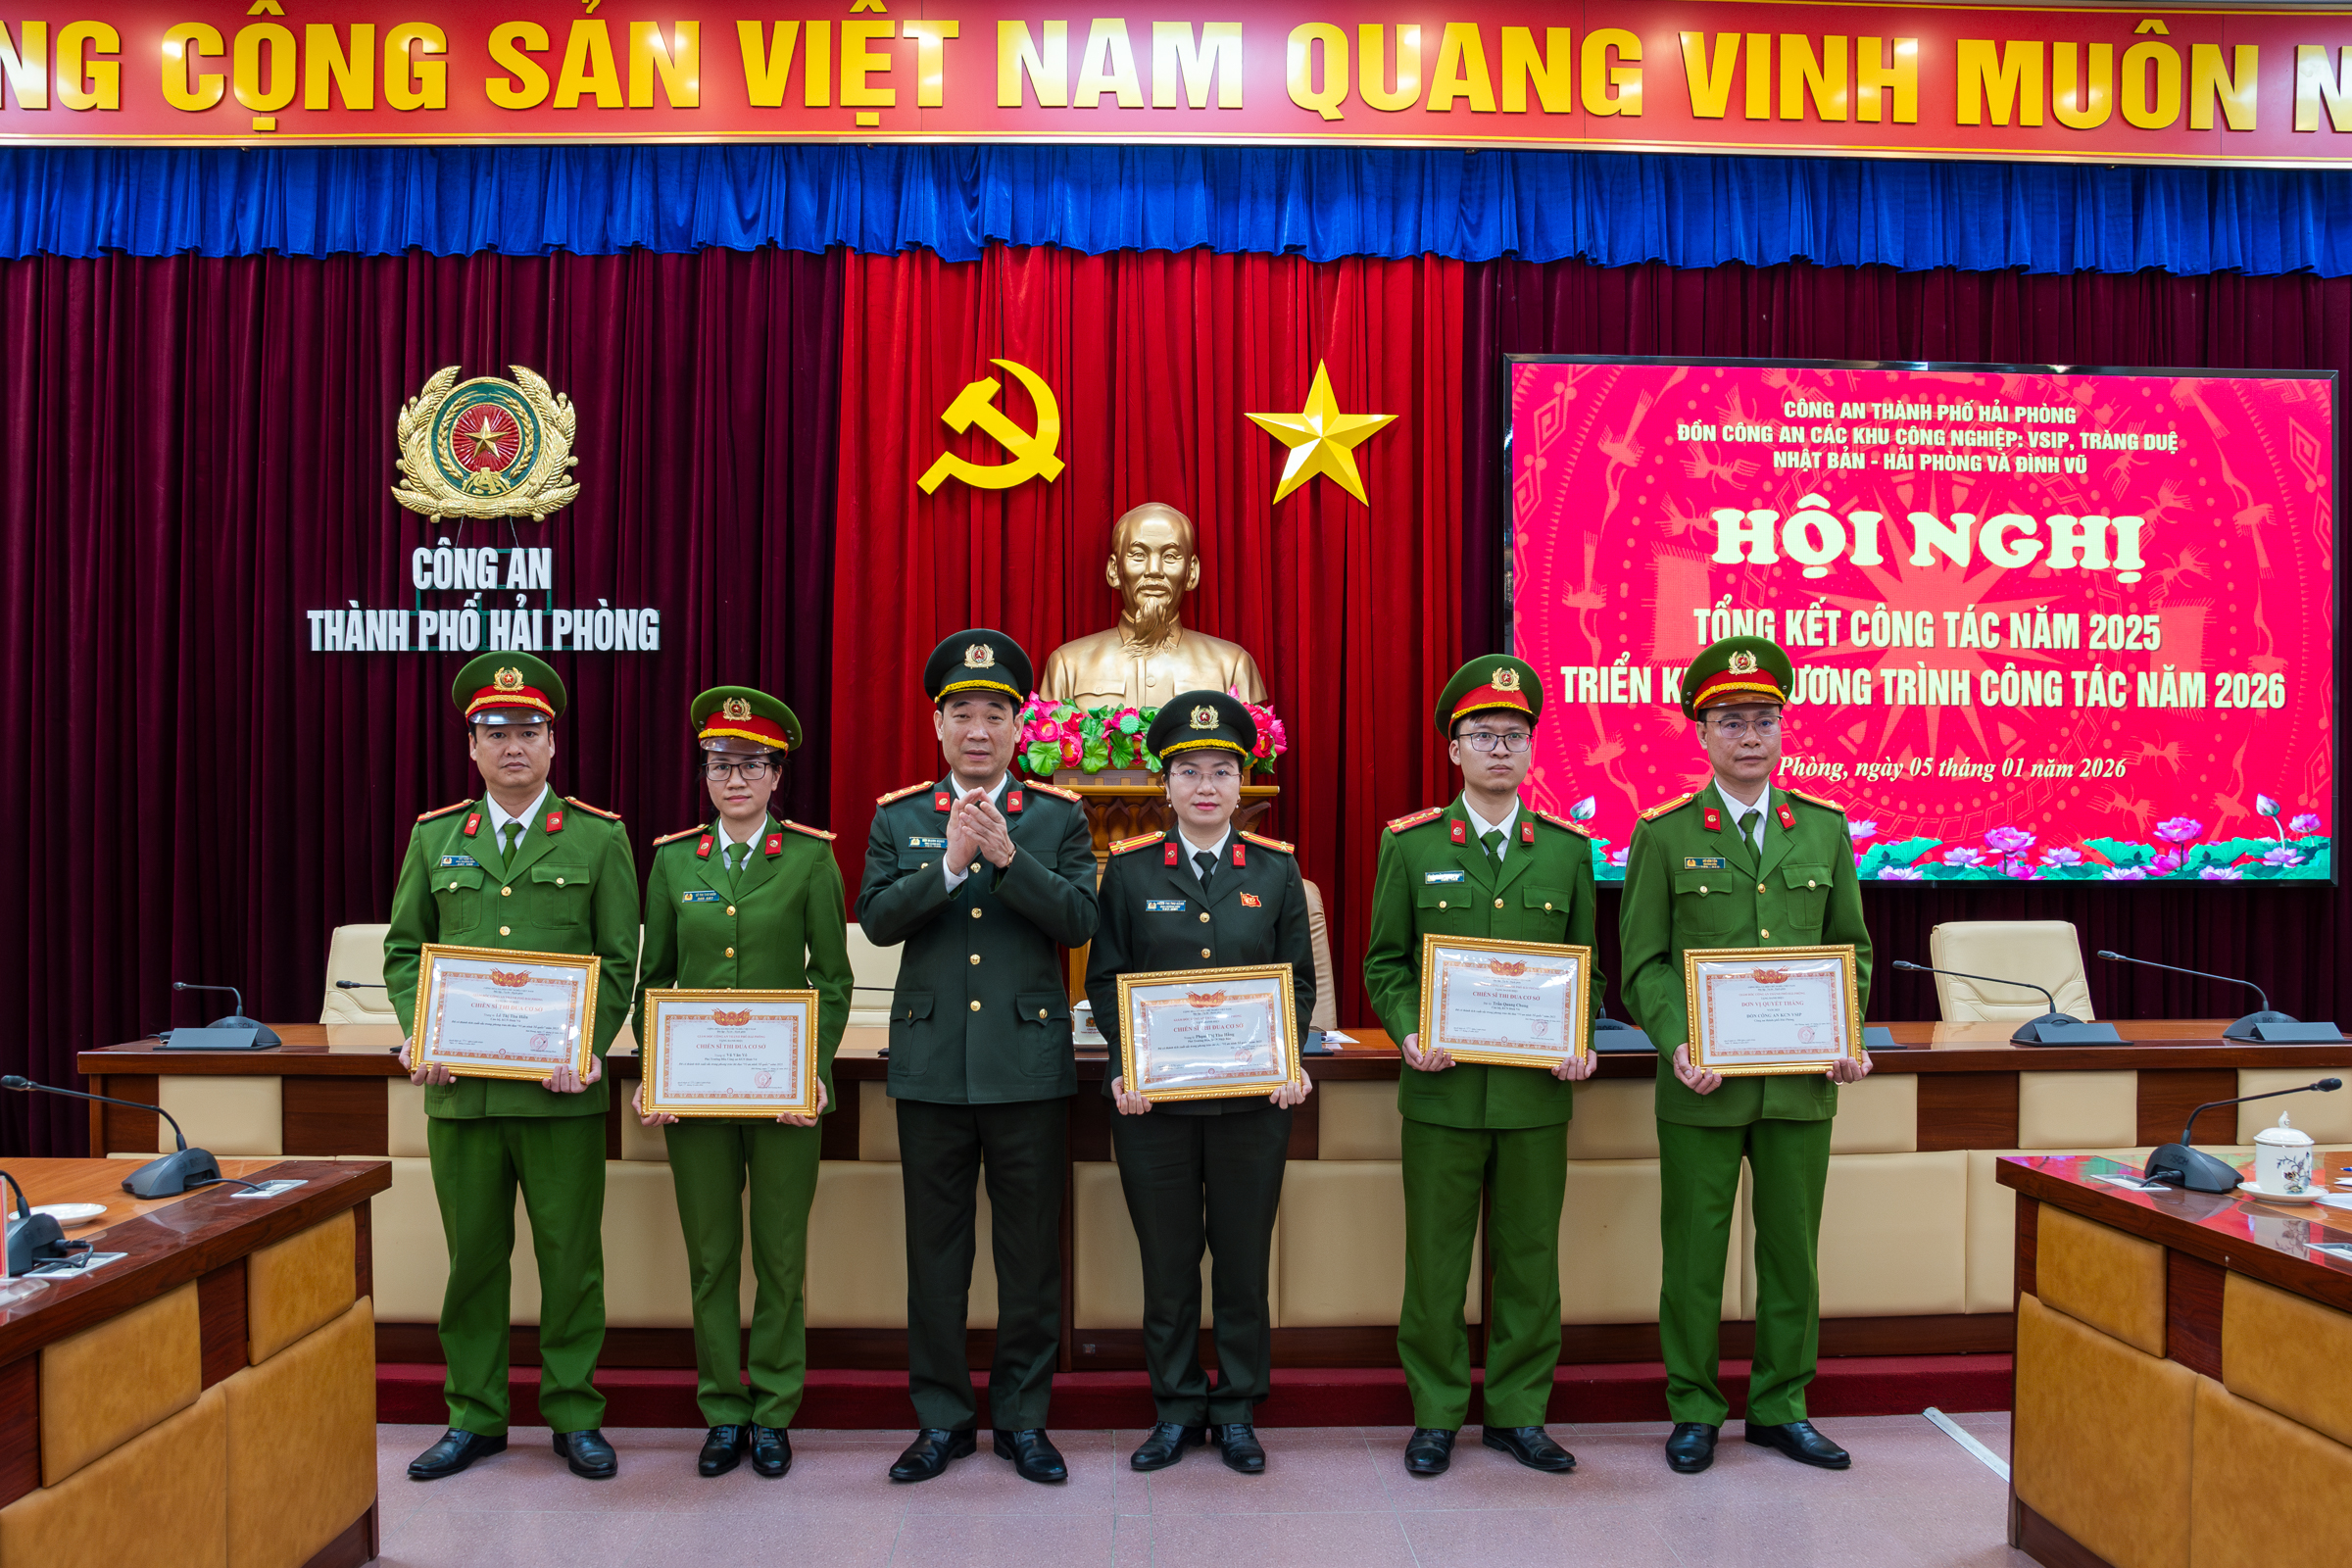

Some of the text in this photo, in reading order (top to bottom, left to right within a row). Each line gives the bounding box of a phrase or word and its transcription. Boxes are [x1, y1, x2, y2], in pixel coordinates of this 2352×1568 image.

[161, 0, 448, 131] CỘNG
[485, 0, 701, 110] SẢN
[736, 0, 959, 126] VIỆT
[997, 18, 1244, 110] NAM
[1286, 22, 1643, 121] QUANG
[1679, 30, 1919, 124] VINH
[1957, 19, 2260, 131] MUÔN
[1677, 418, 2179, 455] ĐỒN CÔNG AN CÁC KHU CÔNG NGHIỆP: VSIP, TRÀNG DUỆ
[1784, 397, 2077, 424] CÔNG AN THÀNH PHỐ HẢI PHÒNG
[1773, 447, 1823, 472] NHẬT
[1827, 445, 1866, 469] BẢN
[1883, 446, 1914, 470] HẢI
[1919, 450, 1983, 472] PHÒNG
[1985, 452, 2011, 472] VÀ
[2014, 452, 2060, 473] ĐÌNH
[2063, 454, 2087, 474] VŨ
[413, 537, 552, 590] CÔNG AN
[1711, 492, 2146, 584] HỘI NGHỊ
[307, 592, 661, 652] THÀNH PHỐ HẢI PHÒNG
[1693, 593, 2161, 652] TỔNG KẾT CÔNG TÁC NĂM 2025
[1560, 651, 1652, 704] TRIỂN
[1880, 661, 1971, 707] TRÌNH
[1980, 662, 2063, 708] CÔNG
[2071, 662, 2127, 709] TÁC
[2136, 663, 2206, 709] NĂM
[2214, 671, 2285, 710] 2026
[1777, 756, 2127, 783] Phòng, ngày 05 tháng 01 năm 2026
